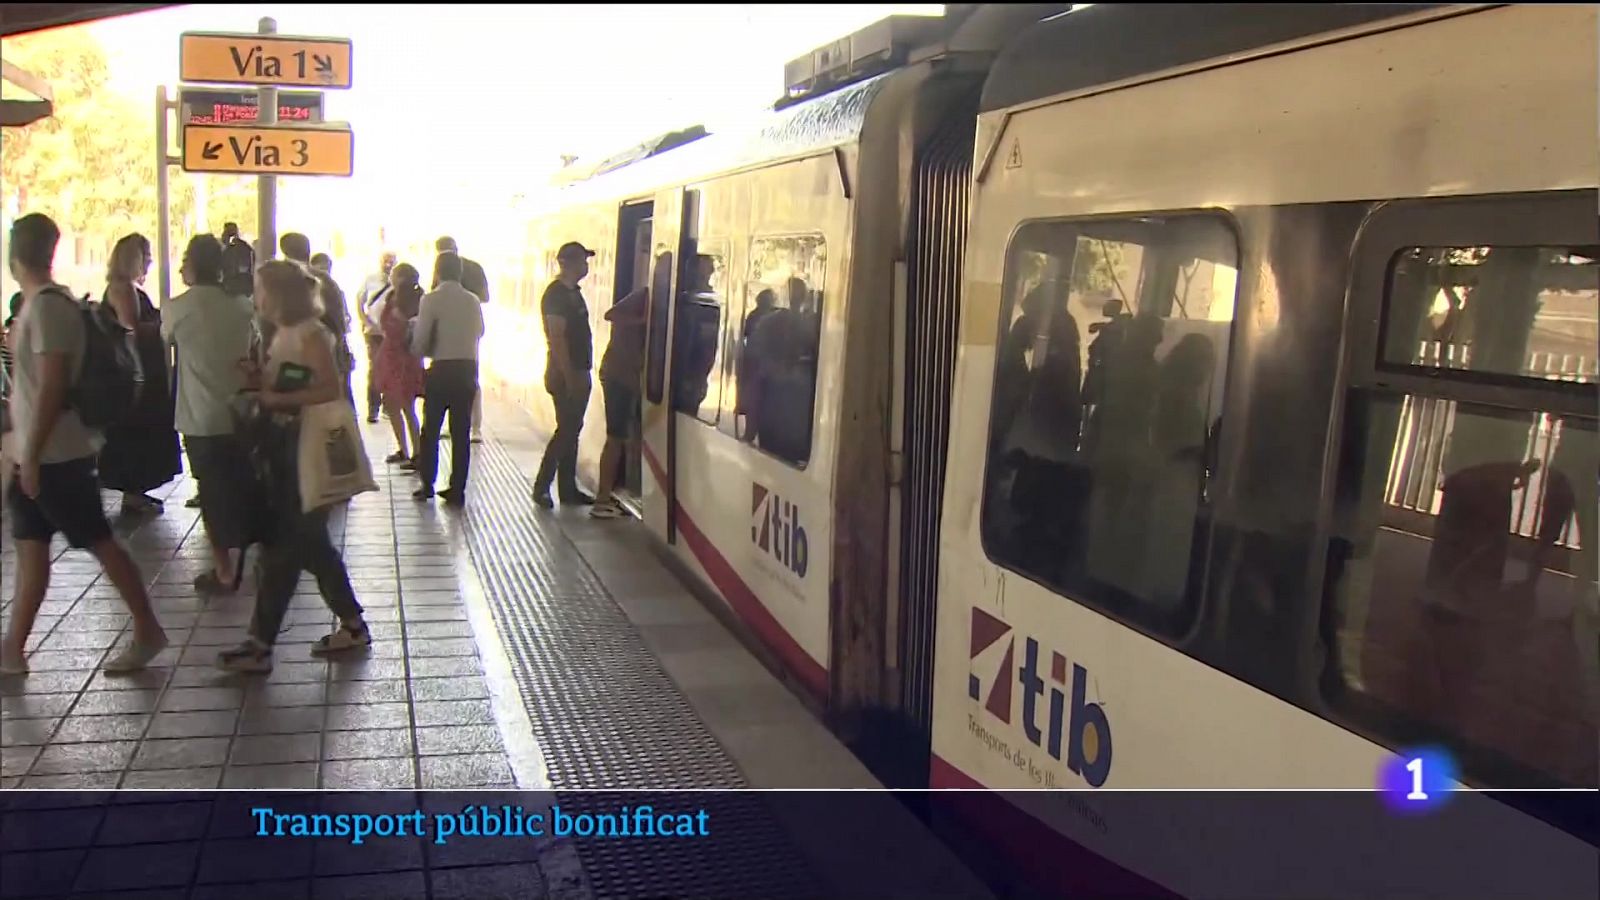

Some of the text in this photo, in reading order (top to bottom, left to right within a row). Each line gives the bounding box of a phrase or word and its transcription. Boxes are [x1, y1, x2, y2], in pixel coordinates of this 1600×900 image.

[229, 46, 306, 78] Via 1
[228, 135, 309, 166] Via 3
[772, 494, 808, 578] tib
[1019, 636, 1112, 788] tib
[967, 713, 1011, 761] Transports
[1013, 749, 1026, 771] de
